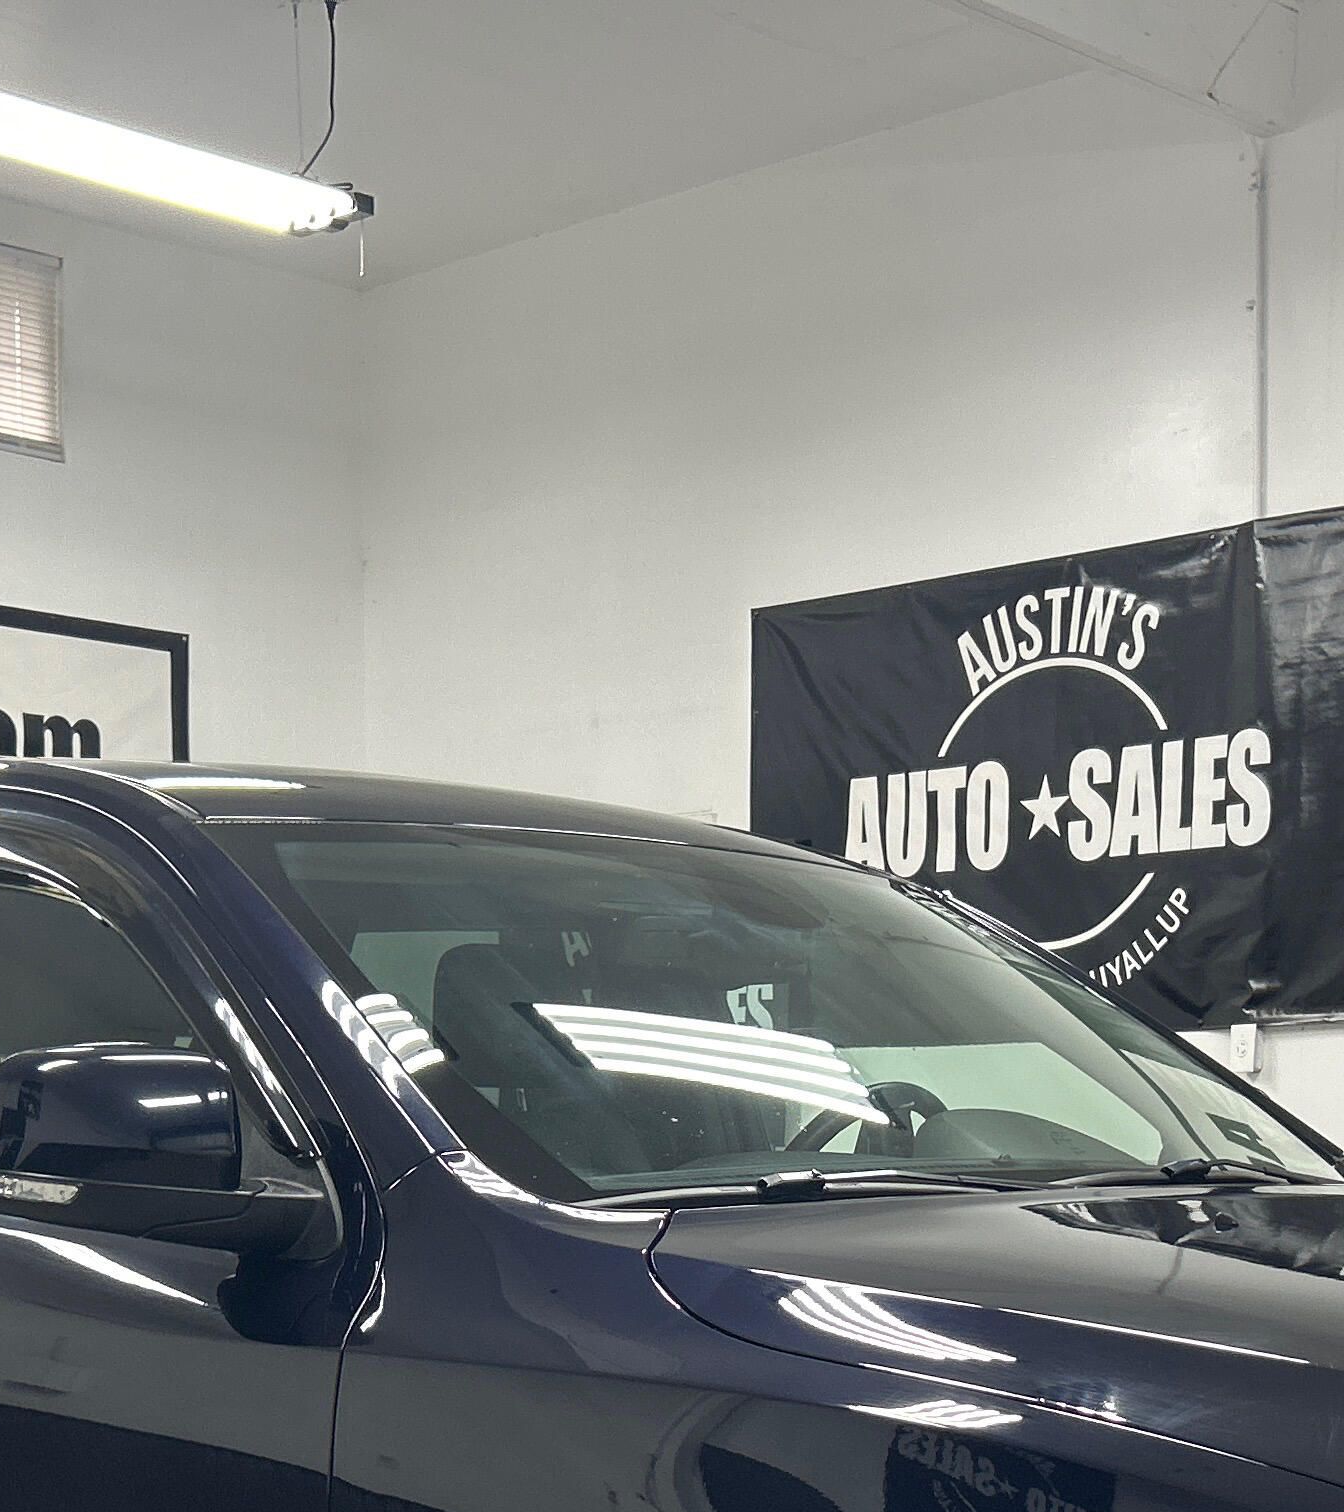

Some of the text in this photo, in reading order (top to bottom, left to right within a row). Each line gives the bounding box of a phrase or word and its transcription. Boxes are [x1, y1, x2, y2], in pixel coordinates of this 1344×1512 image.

[957, 586, 1160, 697] AUSTIN'S
[845, 727, 1272, 878] AUTO SALES
